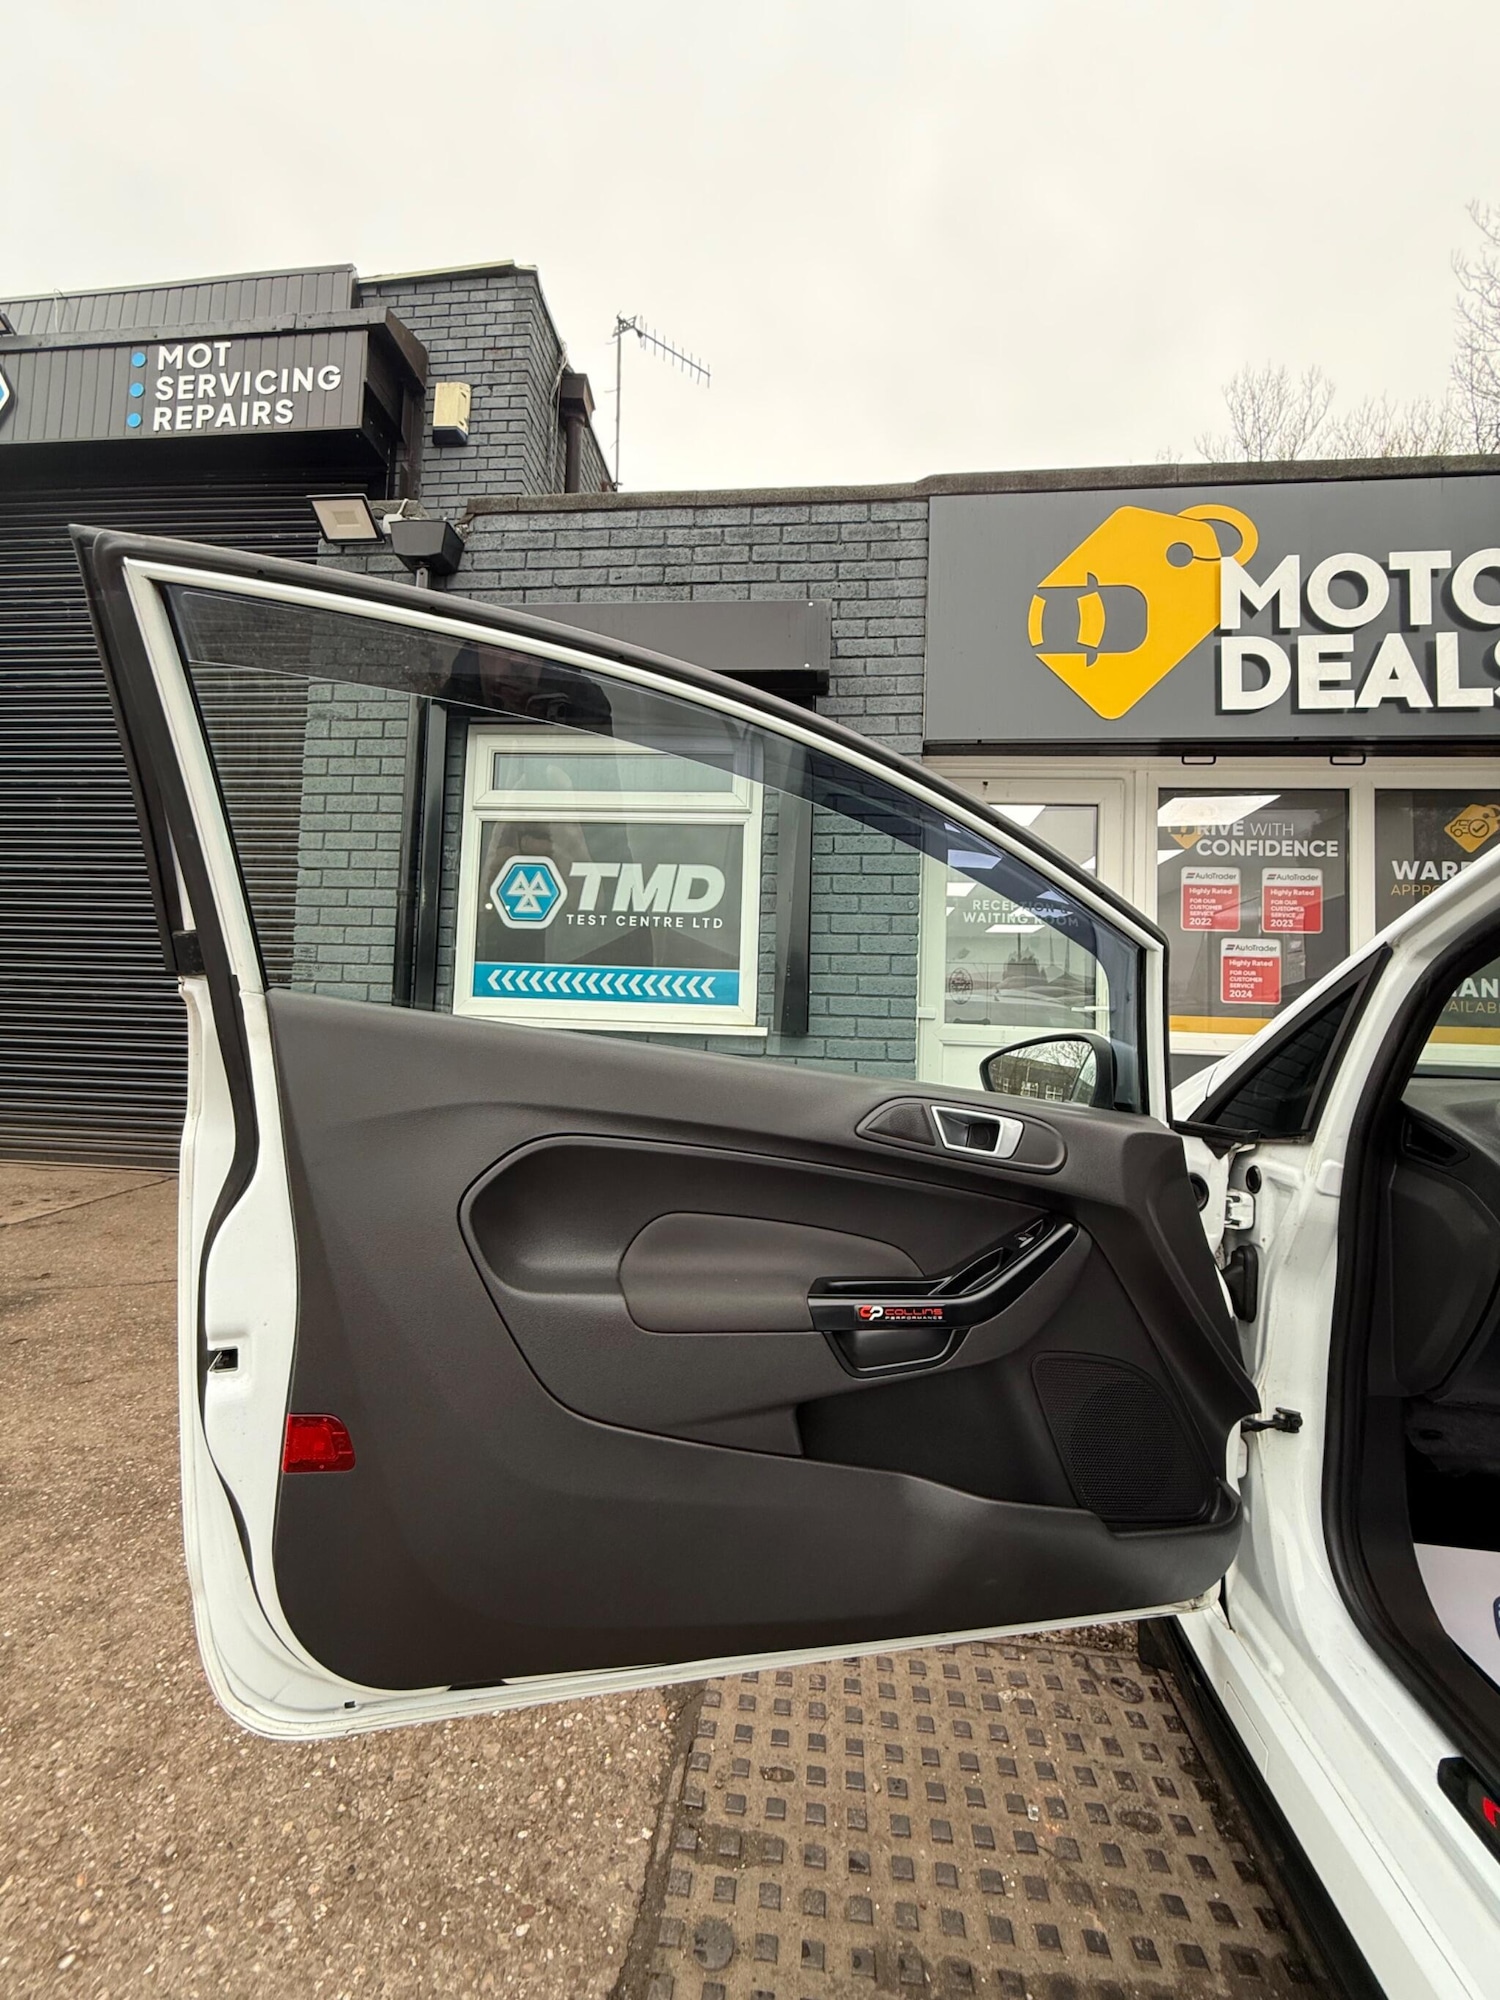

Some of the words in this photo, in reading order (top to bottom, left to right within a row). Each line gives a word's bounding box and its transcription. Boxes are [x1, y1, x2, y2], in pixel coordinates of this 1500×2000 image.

[157, 342, 232, 371] MOT
[154, 365, 342, 401] SERVICING
[153, 399, 294, 431] REPAIRS
[1220, 631, 1500, 710] DEAL
[1250, 822, 1294, 837] WITH
[1196, 839, 1339, 858] CONFIDENCE
[1195, 872, 1237, 880] AutoTrader
[1276, 873, 1319, 881] AutoTrader
[569, 862, 726, 913] TMD
[1189, 887, 1211, 896] Highly
[1211, 887, 1233, 895] Rated
[1270, 888, 1292, 897] Highly
[1292, 888, 1315, 896] Rated
[972, 899, 1055, 913] RECEPTION
[566, 914, 607, 926] TEST
[616, 915, 684, 927] CENTRE
[692, 917, 723, 929] LTD
[963, 911, 1029, 924] WAITING
[1034, 913, 1079, 927] ROOM
[1189, 917, 1212, 926] 2022
[1270, 919, 1294, 928] 2023
[1235, 944, 1278, 952] AutoTrader
[1229, 959, 1251, 968] Highly
[1229, 989, 1253, 999] 2024
